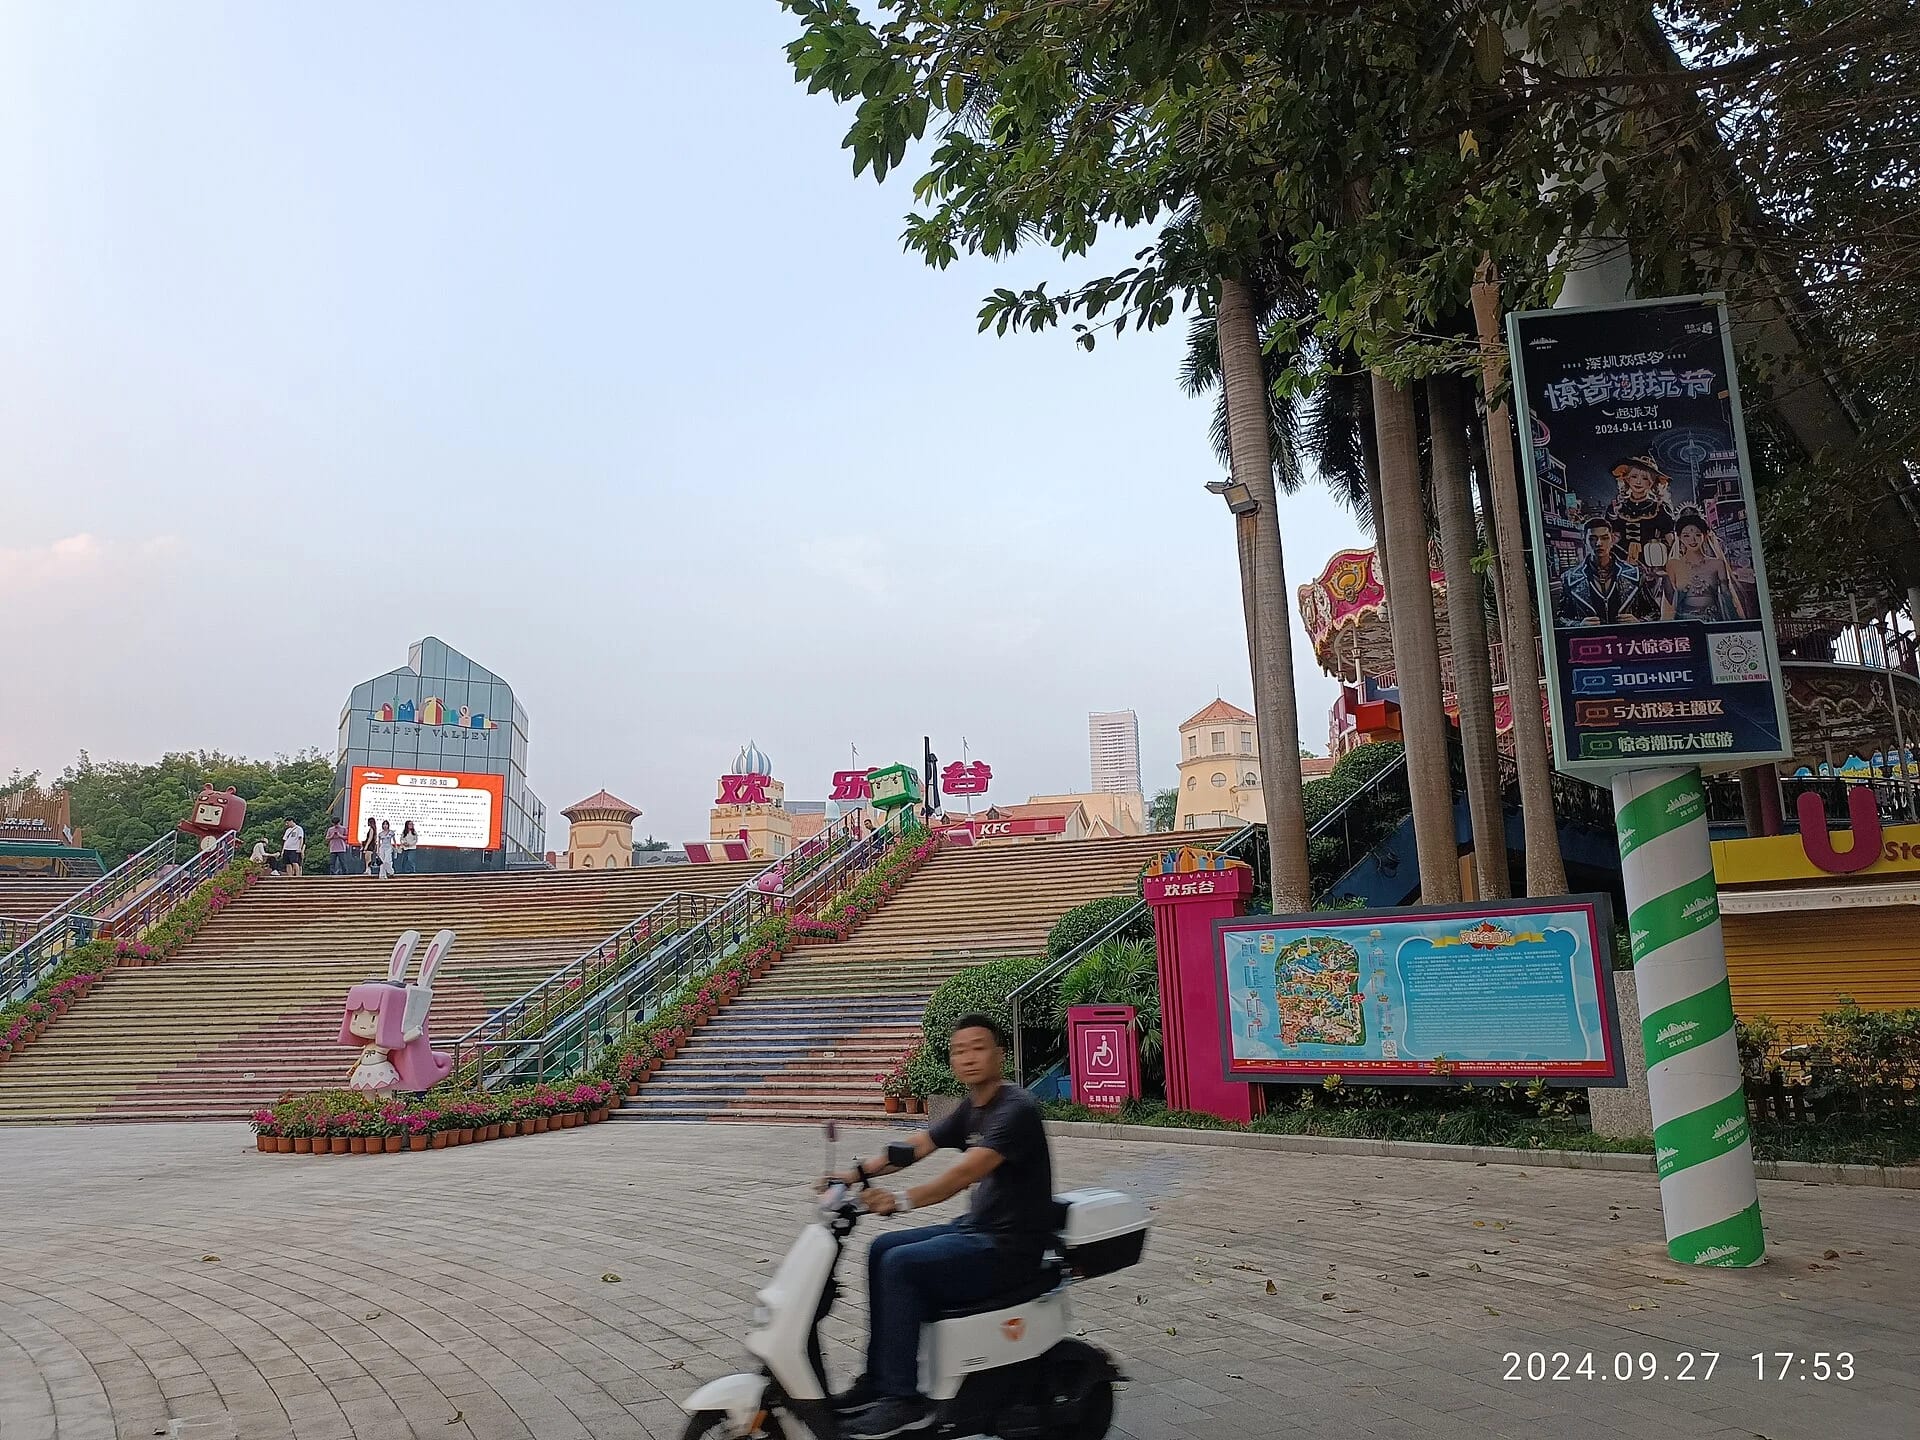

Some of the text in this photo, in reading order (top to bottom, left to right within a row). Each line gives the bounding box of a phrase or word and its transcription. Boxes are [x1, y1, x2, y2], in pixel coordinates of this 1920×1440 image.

[1585, 351, 1664, 370] 深圳欢乐谷
[1544, 368, 1716, 412] 惊奇潮玩节
[1595, 419, 1672, 435] 2024.9.14-11.10
[1605, 637, 1691, 656] 11大惊奇屋
[1612, 670, 1694, 687] 300+NPC
[1613, 699, 1724, 719] 5大沉浸主题区
[371, 724, 489, 741] HAPPY VALLEY
[1617, 731, 1734, 752] 惊奇潮玩大巡游
[980, 822, 1011, 835] KFC
[1189, 870, 1234, 879] VALLEY
[1163, 880, 1215, 897] 欢乐谷
